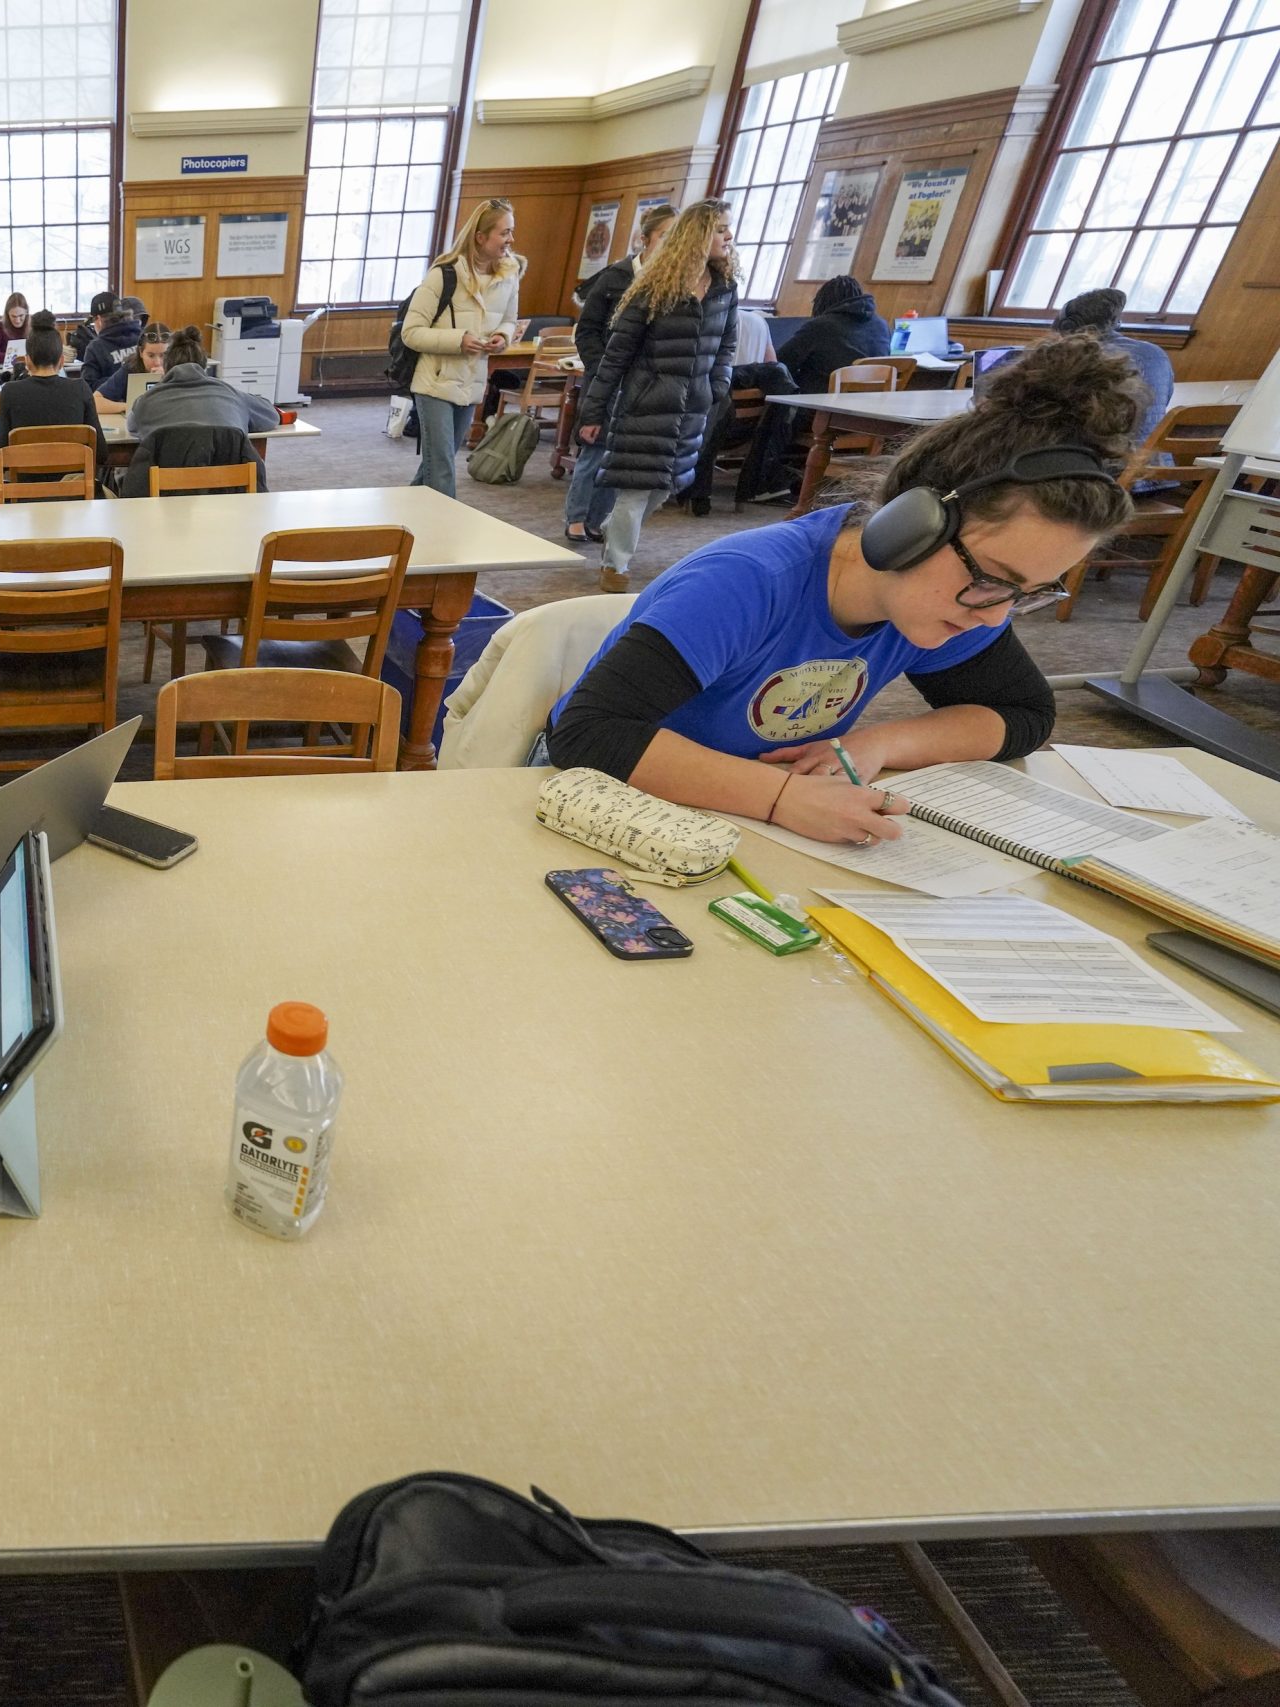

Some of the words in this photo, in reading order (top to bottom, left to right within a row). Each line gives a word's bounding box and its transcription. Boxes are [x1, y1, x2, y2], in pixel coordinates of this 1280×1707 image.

[183, 157, 246, 169] Photocopiers
[924, 178, 948, 187] found
[164, 238, 191, 255] WGS
[240, 1143, 300, 1175] GATORLYTE
